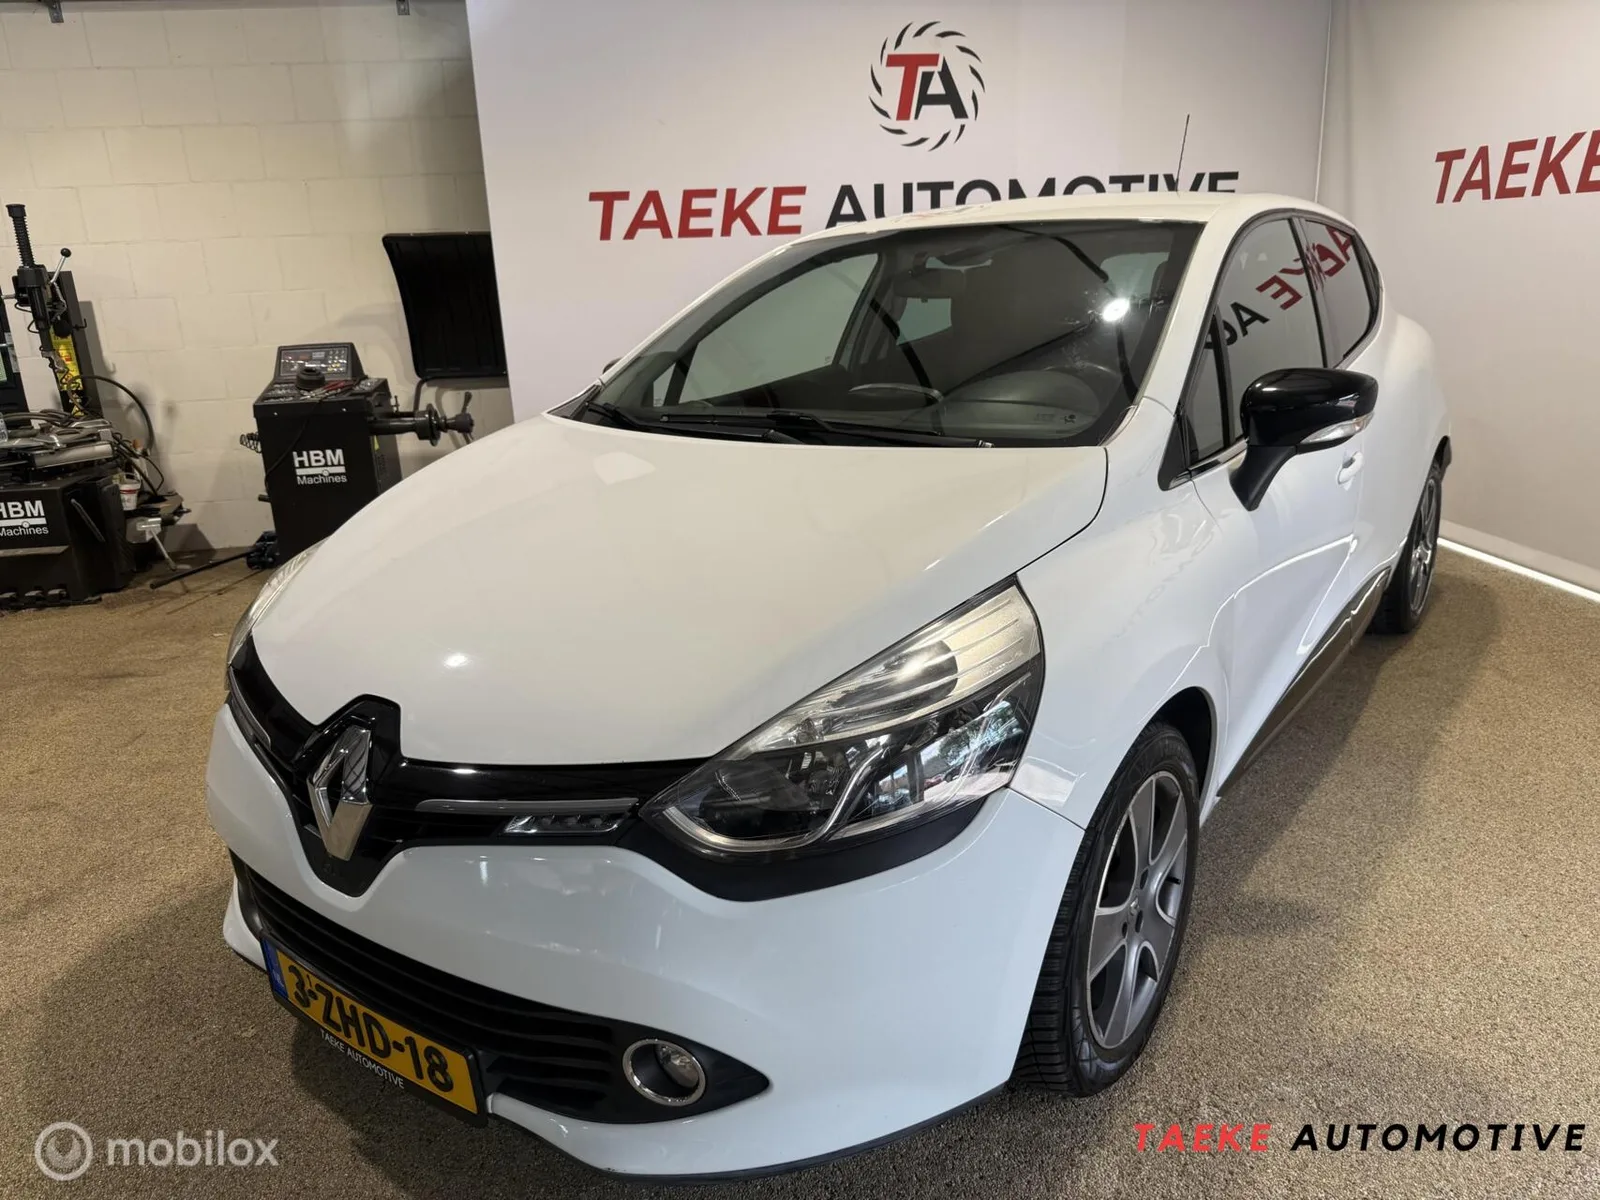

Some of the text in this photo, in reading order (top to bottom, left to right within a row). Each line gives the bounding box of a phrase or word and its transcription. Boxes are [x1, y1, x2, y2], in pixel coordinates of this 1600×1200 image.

[886, 53, 968, 121] TA
[589, 186, 807, 241] TAEKE
[292, 448, 345, 468] HBM
[297, 473, 347, 486] Machines
[288, 965, 454, 1093] 3-ZHD-18
[320, 1029, 405, 1089] TAEKE AUTOMOTIVE
